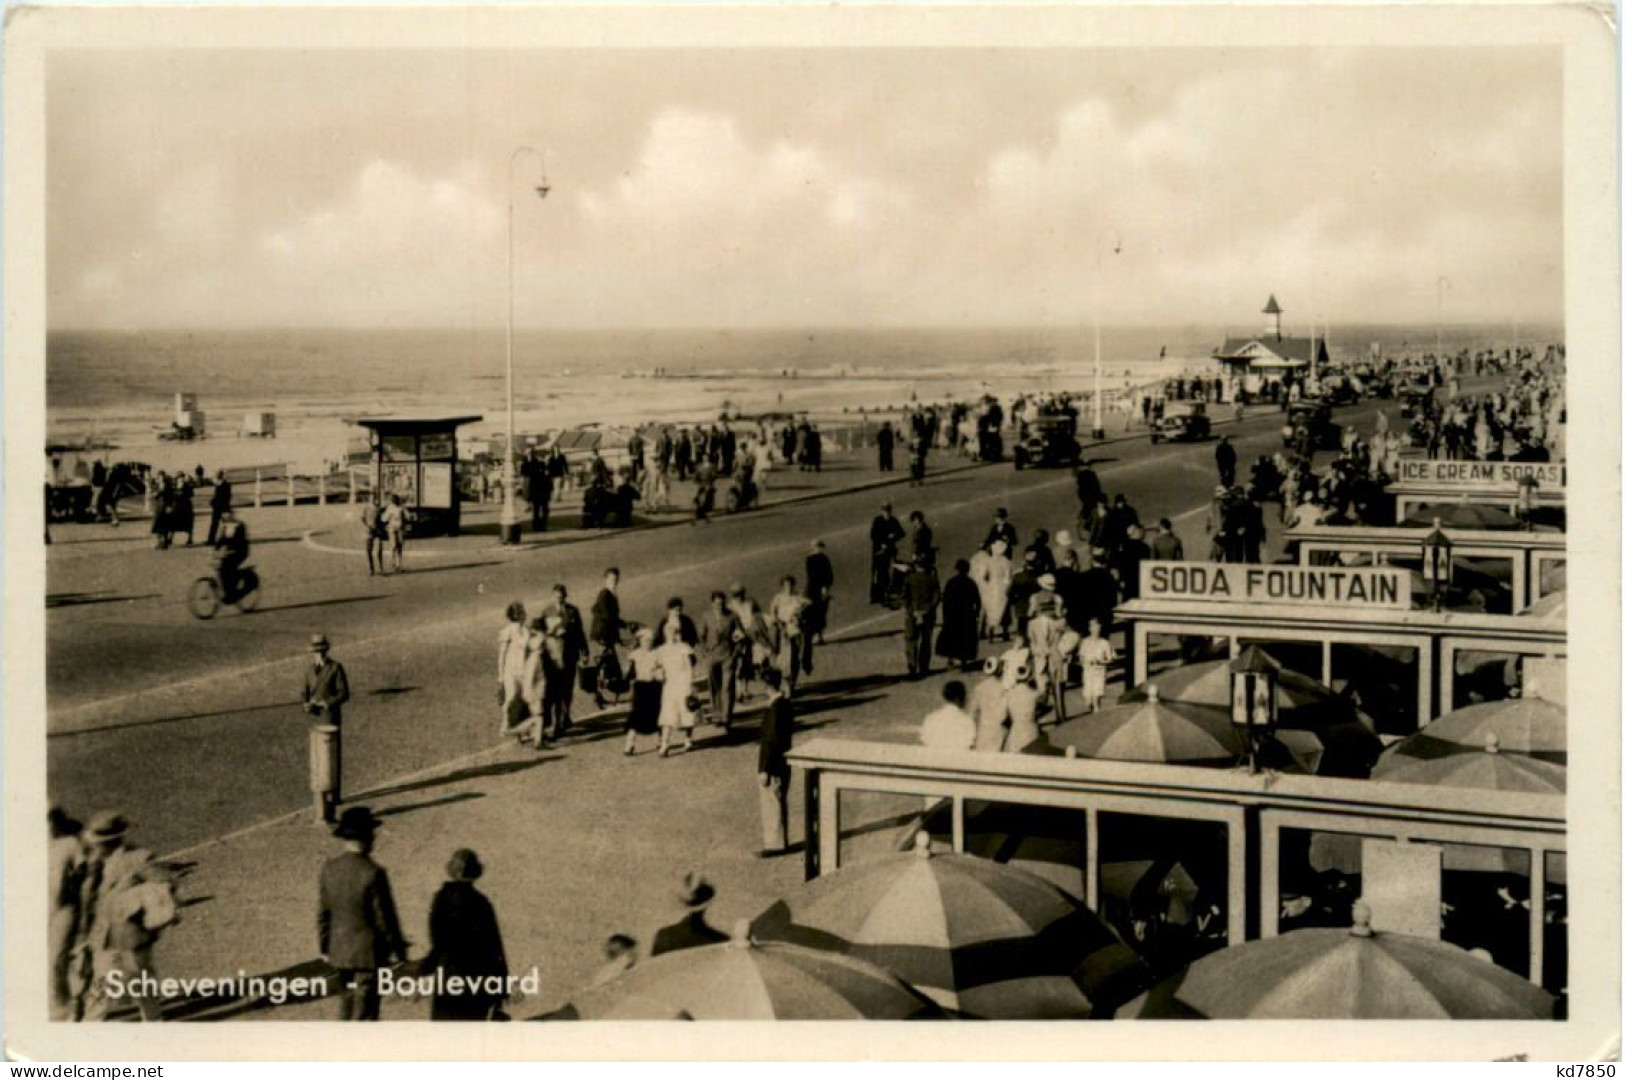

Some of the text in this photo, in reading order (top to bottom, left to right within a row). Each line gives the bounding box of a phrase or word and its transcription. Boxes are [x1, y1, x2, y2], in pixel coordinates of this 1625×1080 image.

[1402, 462, 1429, 479] ICE
[1436, 463, 1494, 481] CREAM
[1151, 566, 1398, 603] SODA FOUNTAIN
